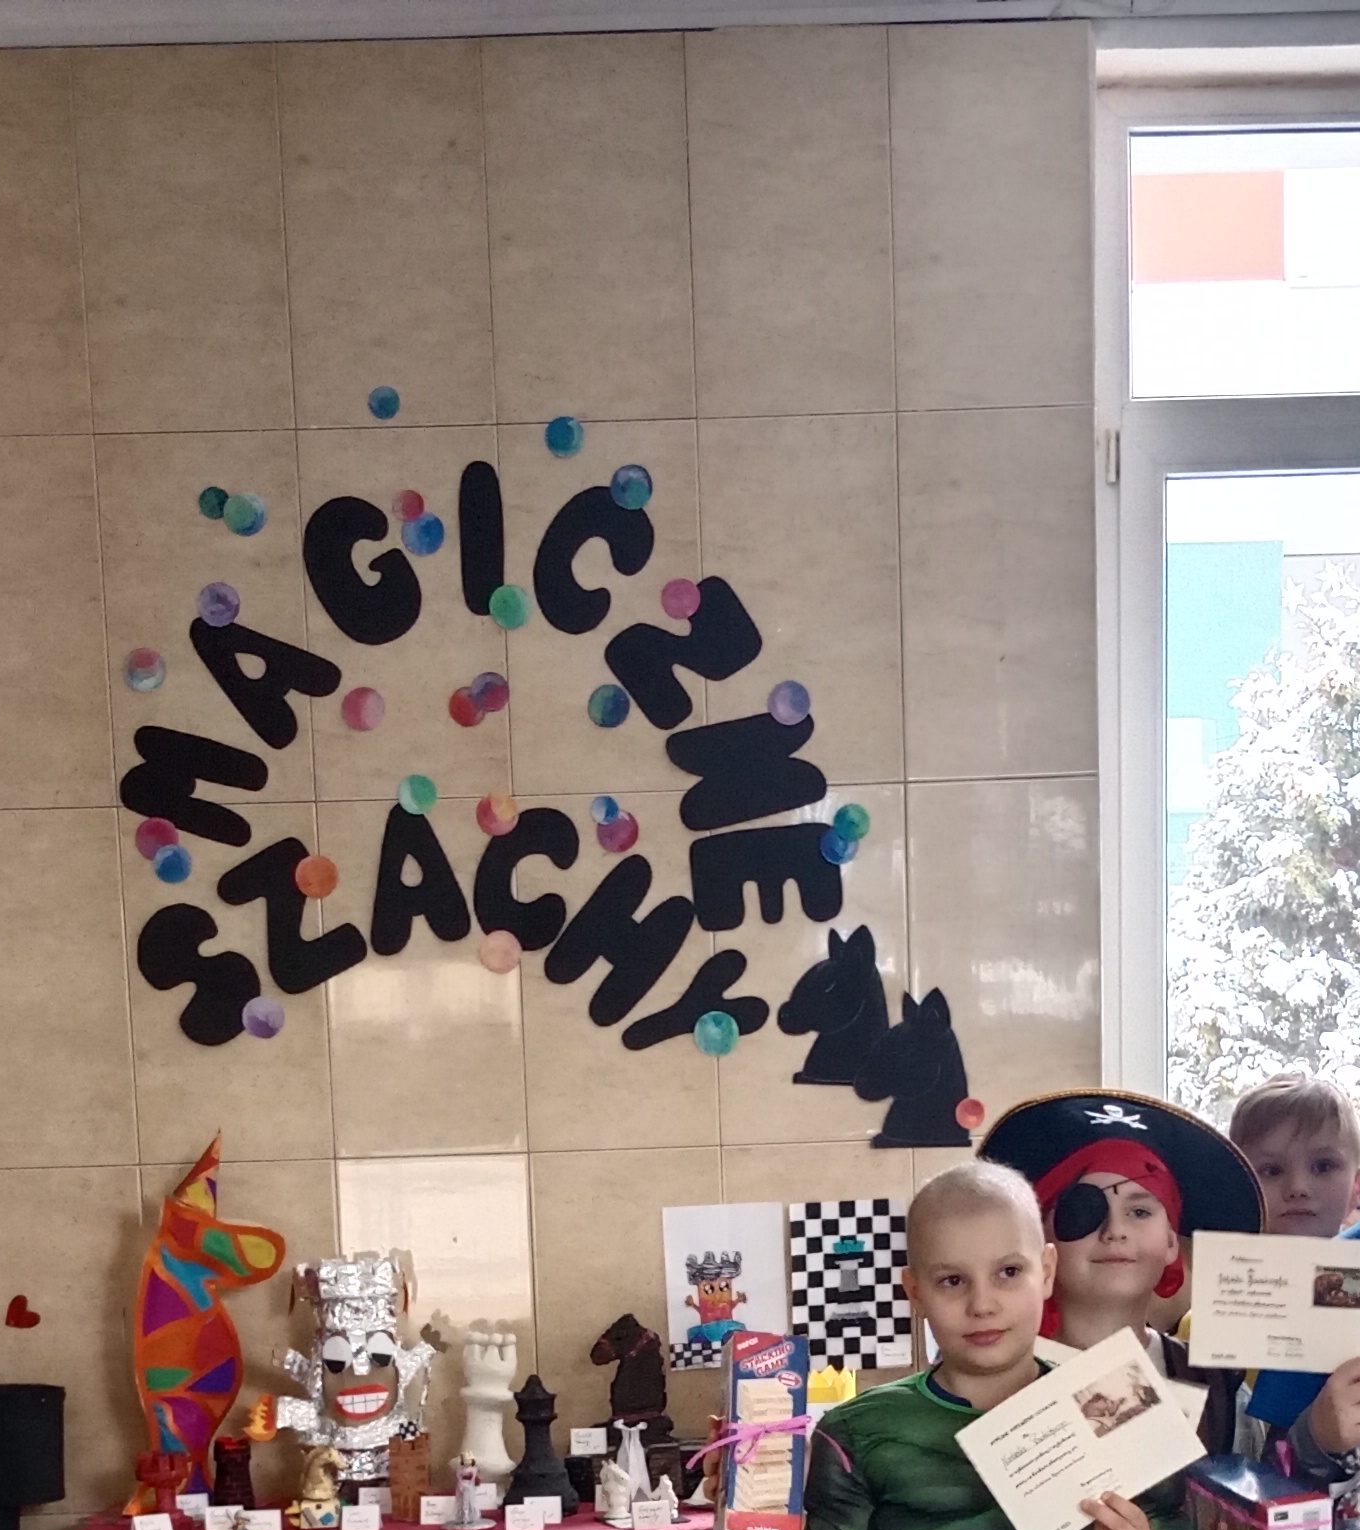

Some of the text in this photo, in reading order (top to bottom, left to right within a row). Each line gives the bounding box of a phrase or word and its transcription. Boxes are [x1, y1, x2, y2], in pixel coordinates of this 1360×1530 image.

[120, 461, 843, 931] MAGICZNE
[137, 803, 770, 1051] SZACHY
[741, 1343, 792, 1370] STACKING
